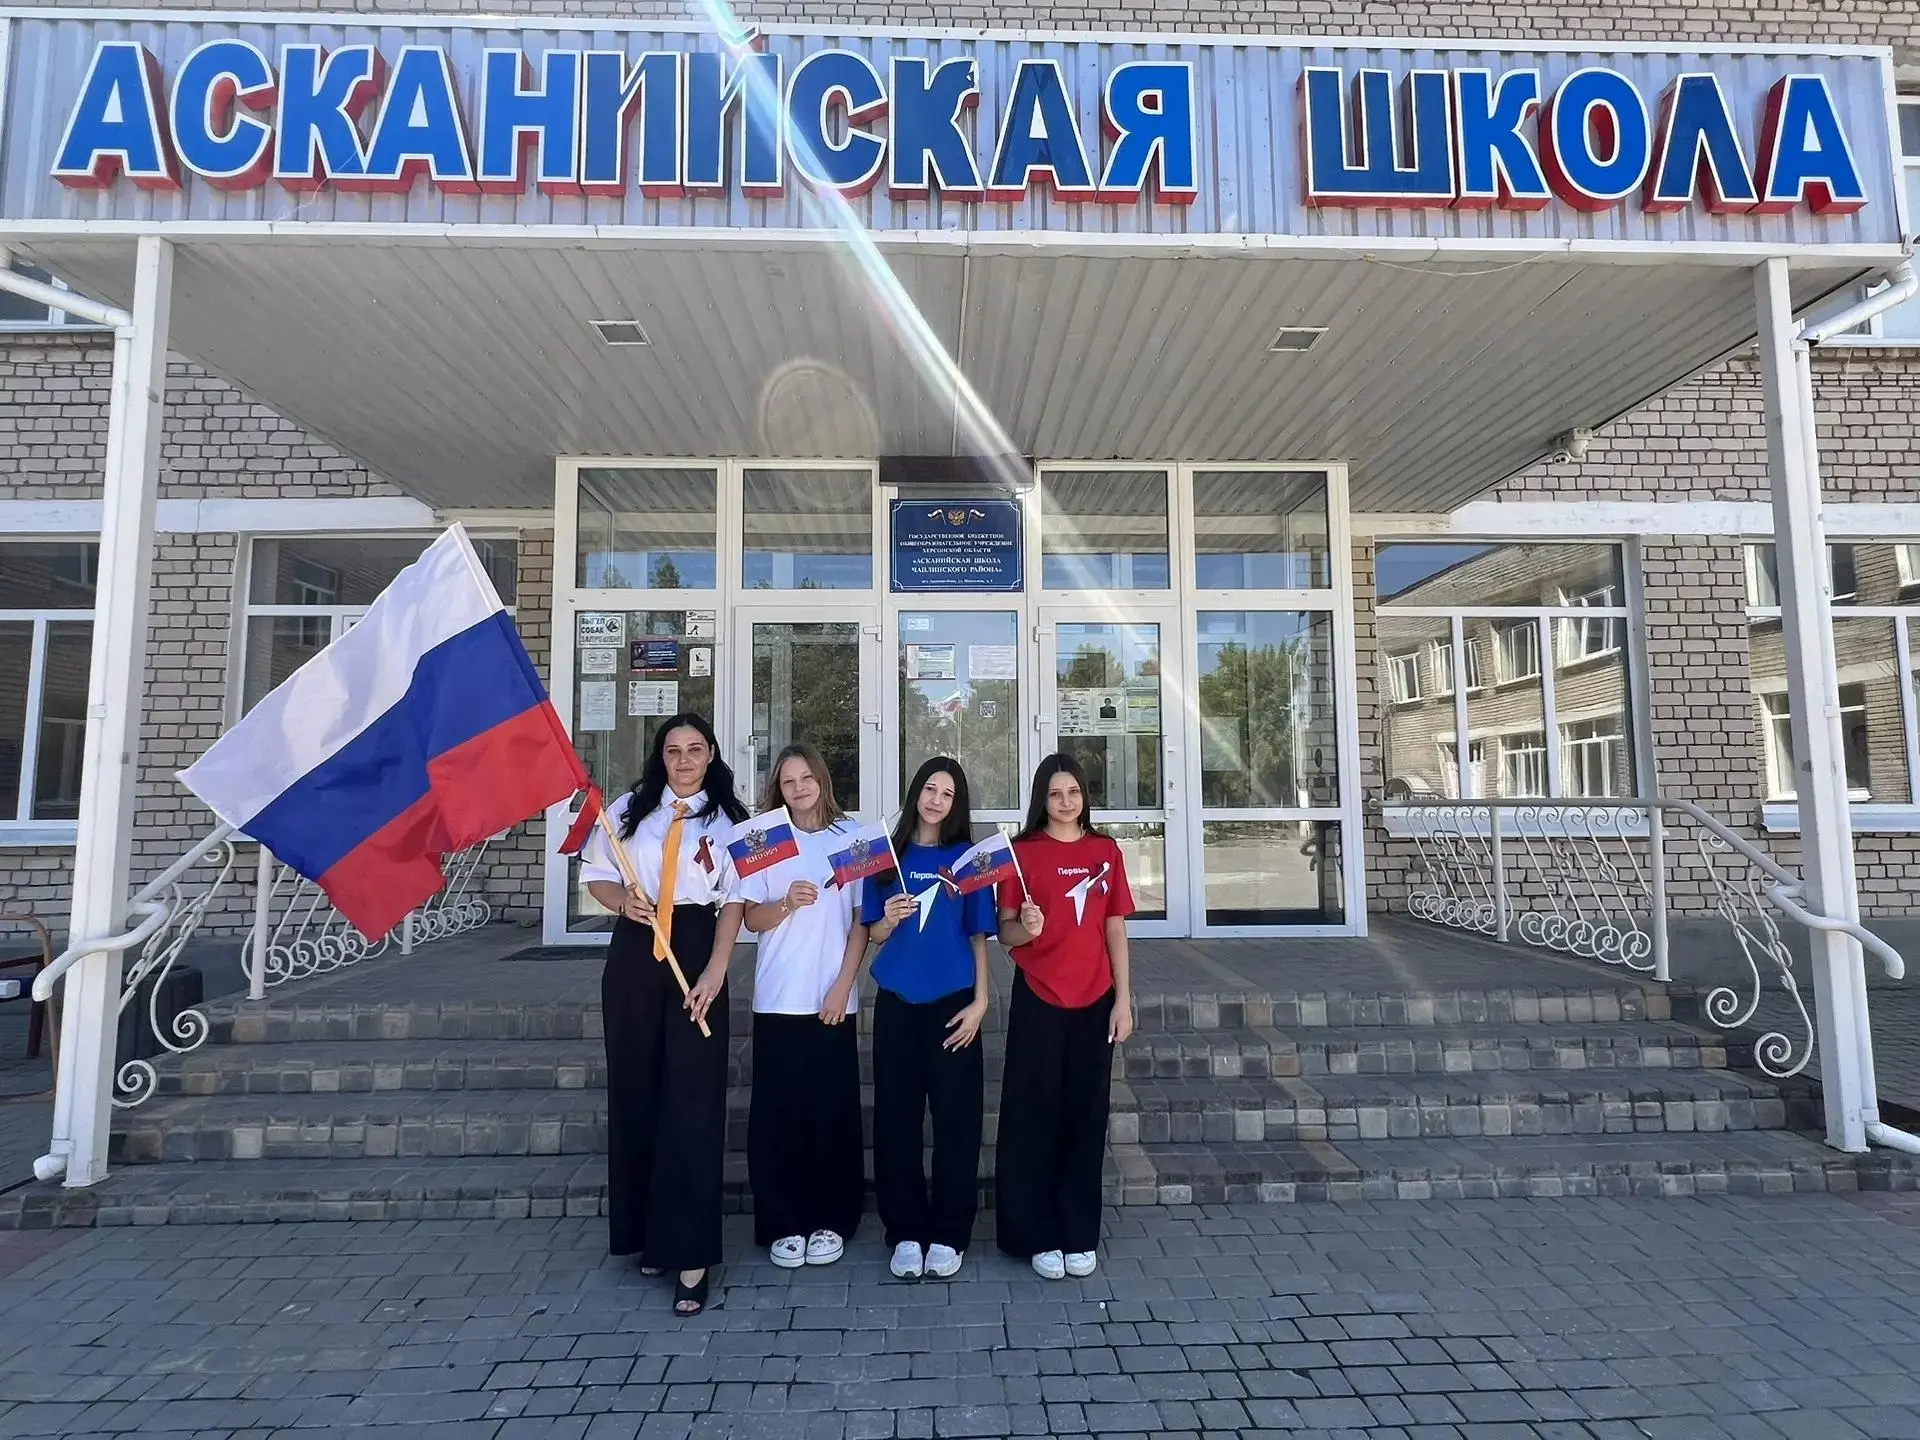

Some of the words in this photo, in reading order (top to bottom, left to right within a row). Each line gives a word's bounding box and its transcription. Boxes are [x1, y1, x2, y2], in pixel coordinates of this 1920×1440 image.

[51, 23, 1198, 205] АСКАНИЙСКАЯ
[1299, 65, 1868, 214] ШКОЛА
[1057, 866, 1090, 877] Первые
